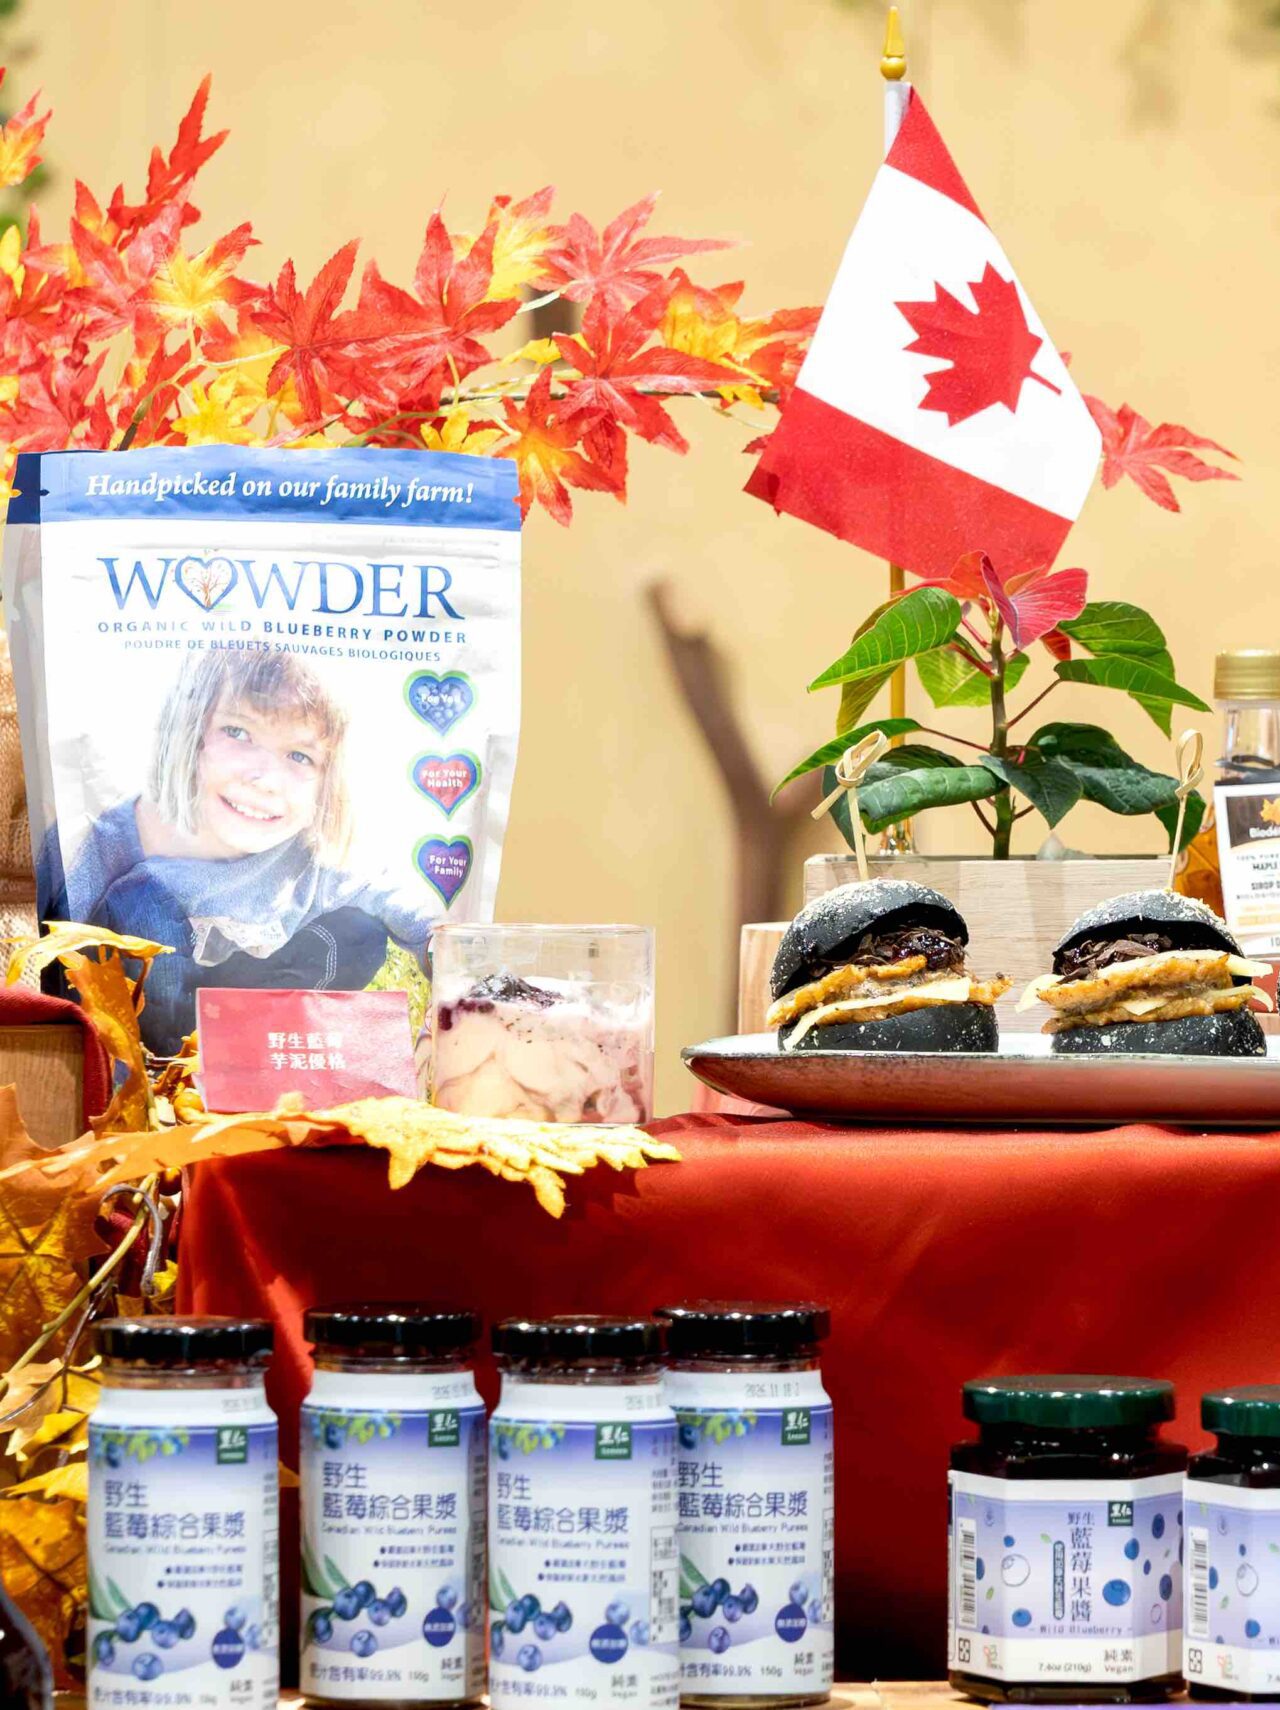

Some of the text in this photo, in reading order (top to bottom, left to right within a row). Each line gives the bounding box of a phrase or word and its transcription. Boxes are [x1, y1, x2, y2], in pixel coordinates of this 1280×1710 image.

[85, 472, 474, 507] Handpicked on our family farm!
[98, 620, 466, 643] ORGANIC WILD BLUEBERRY POWDER
[124, 639, 441, 662] POUDRE DE BLEUETS SAUVAGES BIOLOGIQUES
[422, 768, 467, 778] For Your
[427, 778, 463, 788] Health
[429, 855, 467, 867] For Your
[434, 865, 464, 878] Family
[270, 1052, 347, 1071] 芋泥優格
[322, 1461, 368, 1489] 野生
[678, 1460, 724, 1488] 野生
[104, 1479, 149, 1508] 野生
[497, 1472, 532, 1500] 野生
[322, 1492, 457, 1521] 藍莓綜合果漿
[678, 1490, 809, 1518] 藍莓綜合果漿
[1067, 1511, 1095, 1526] 野生
[1070, 1526, 1093, 1622] 藍莓果醬
[1104, 1664, 1134, 1674] Vegan
